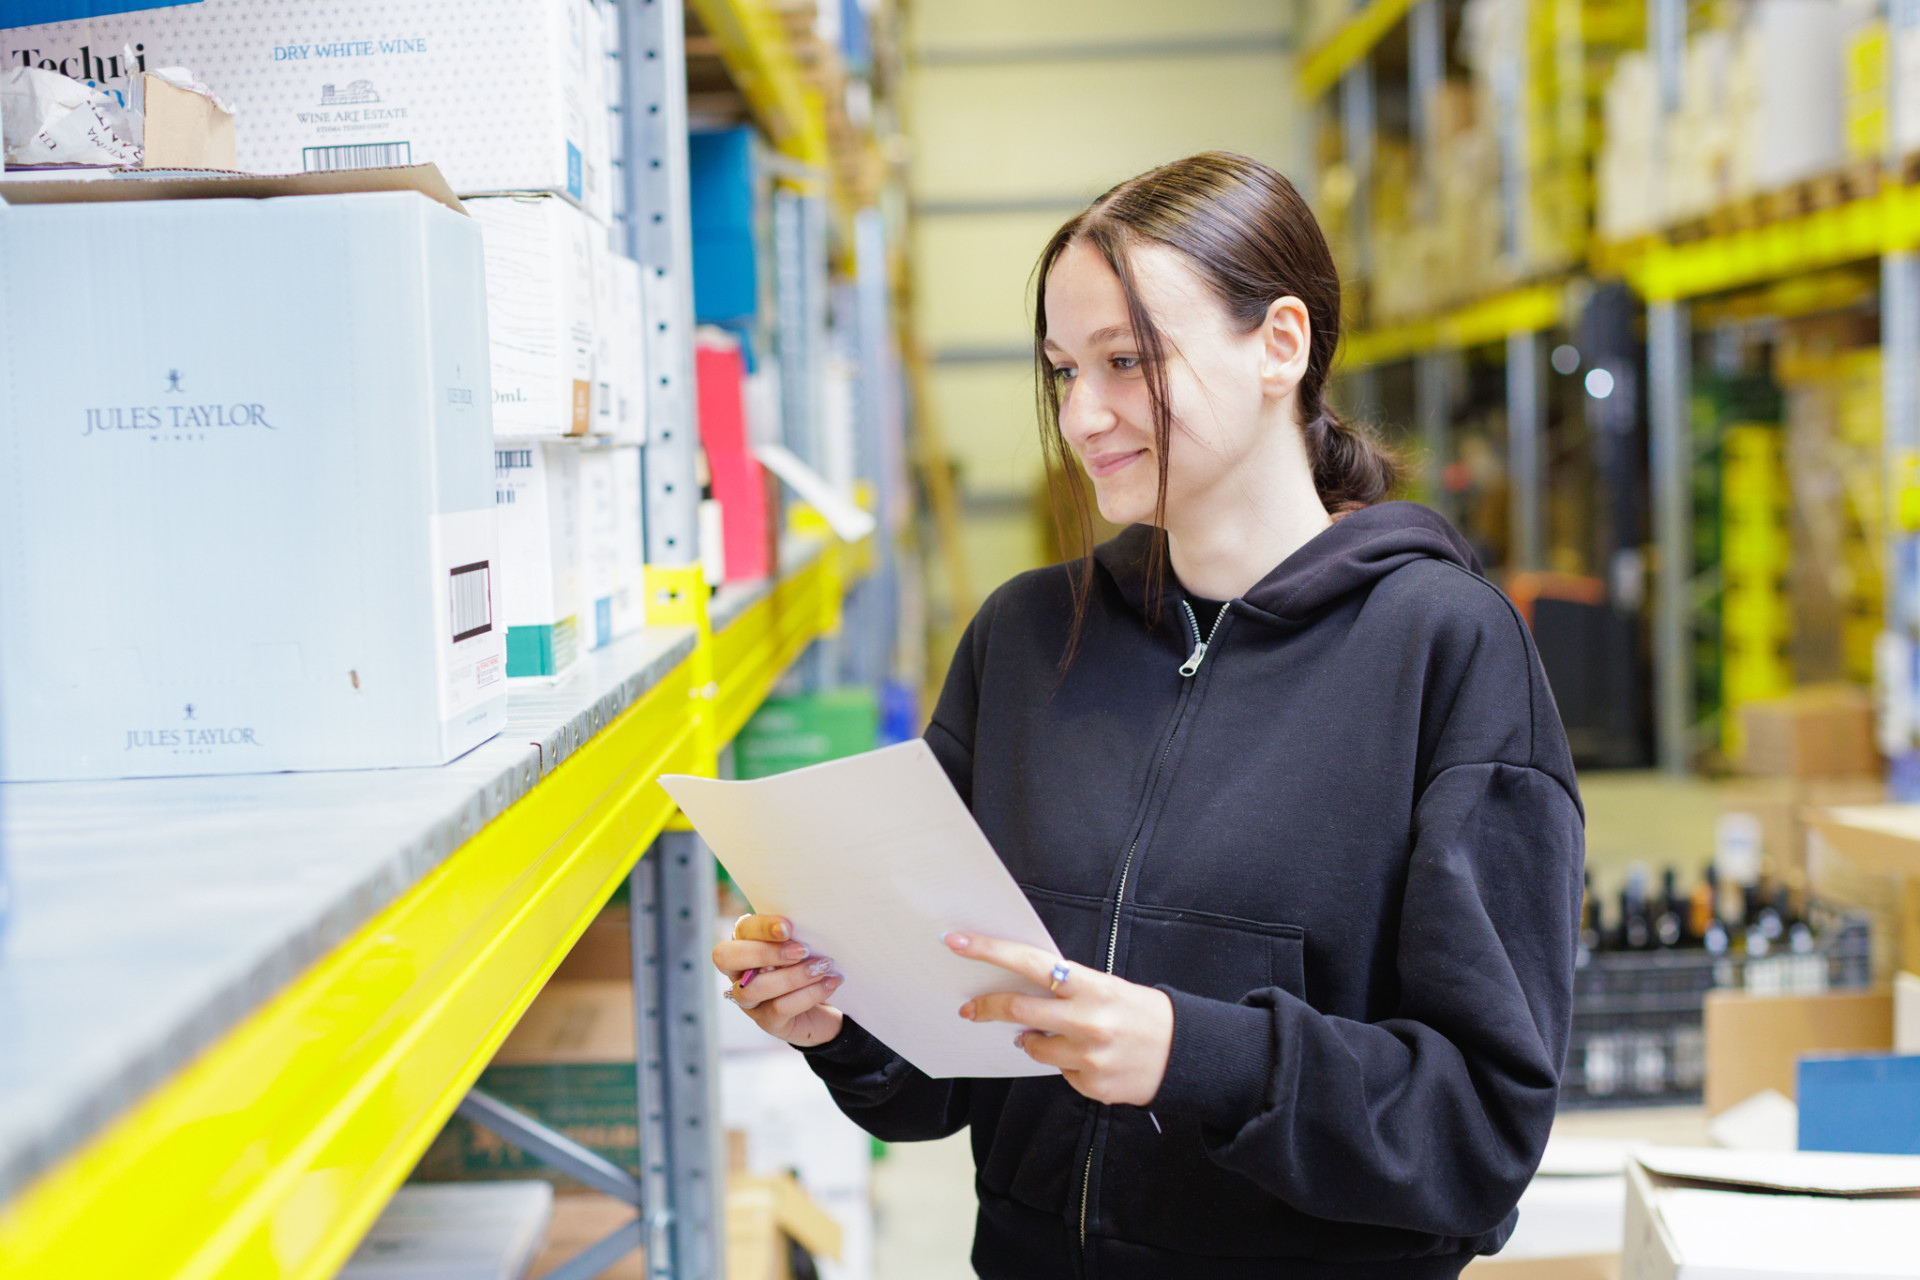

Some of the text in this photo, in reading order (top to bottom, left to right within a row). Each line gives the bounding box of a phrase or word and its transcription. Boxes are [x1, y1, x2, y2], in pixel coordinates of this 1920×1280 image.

[273, 38, 427, 61] DRY WHITE WINE
[296, 108, 408, 124] WINE ART ESTATE
[81, 403, 279, 436] JULES TAYLOR
[123, 727, 265, 751] JULES TAYLOR
